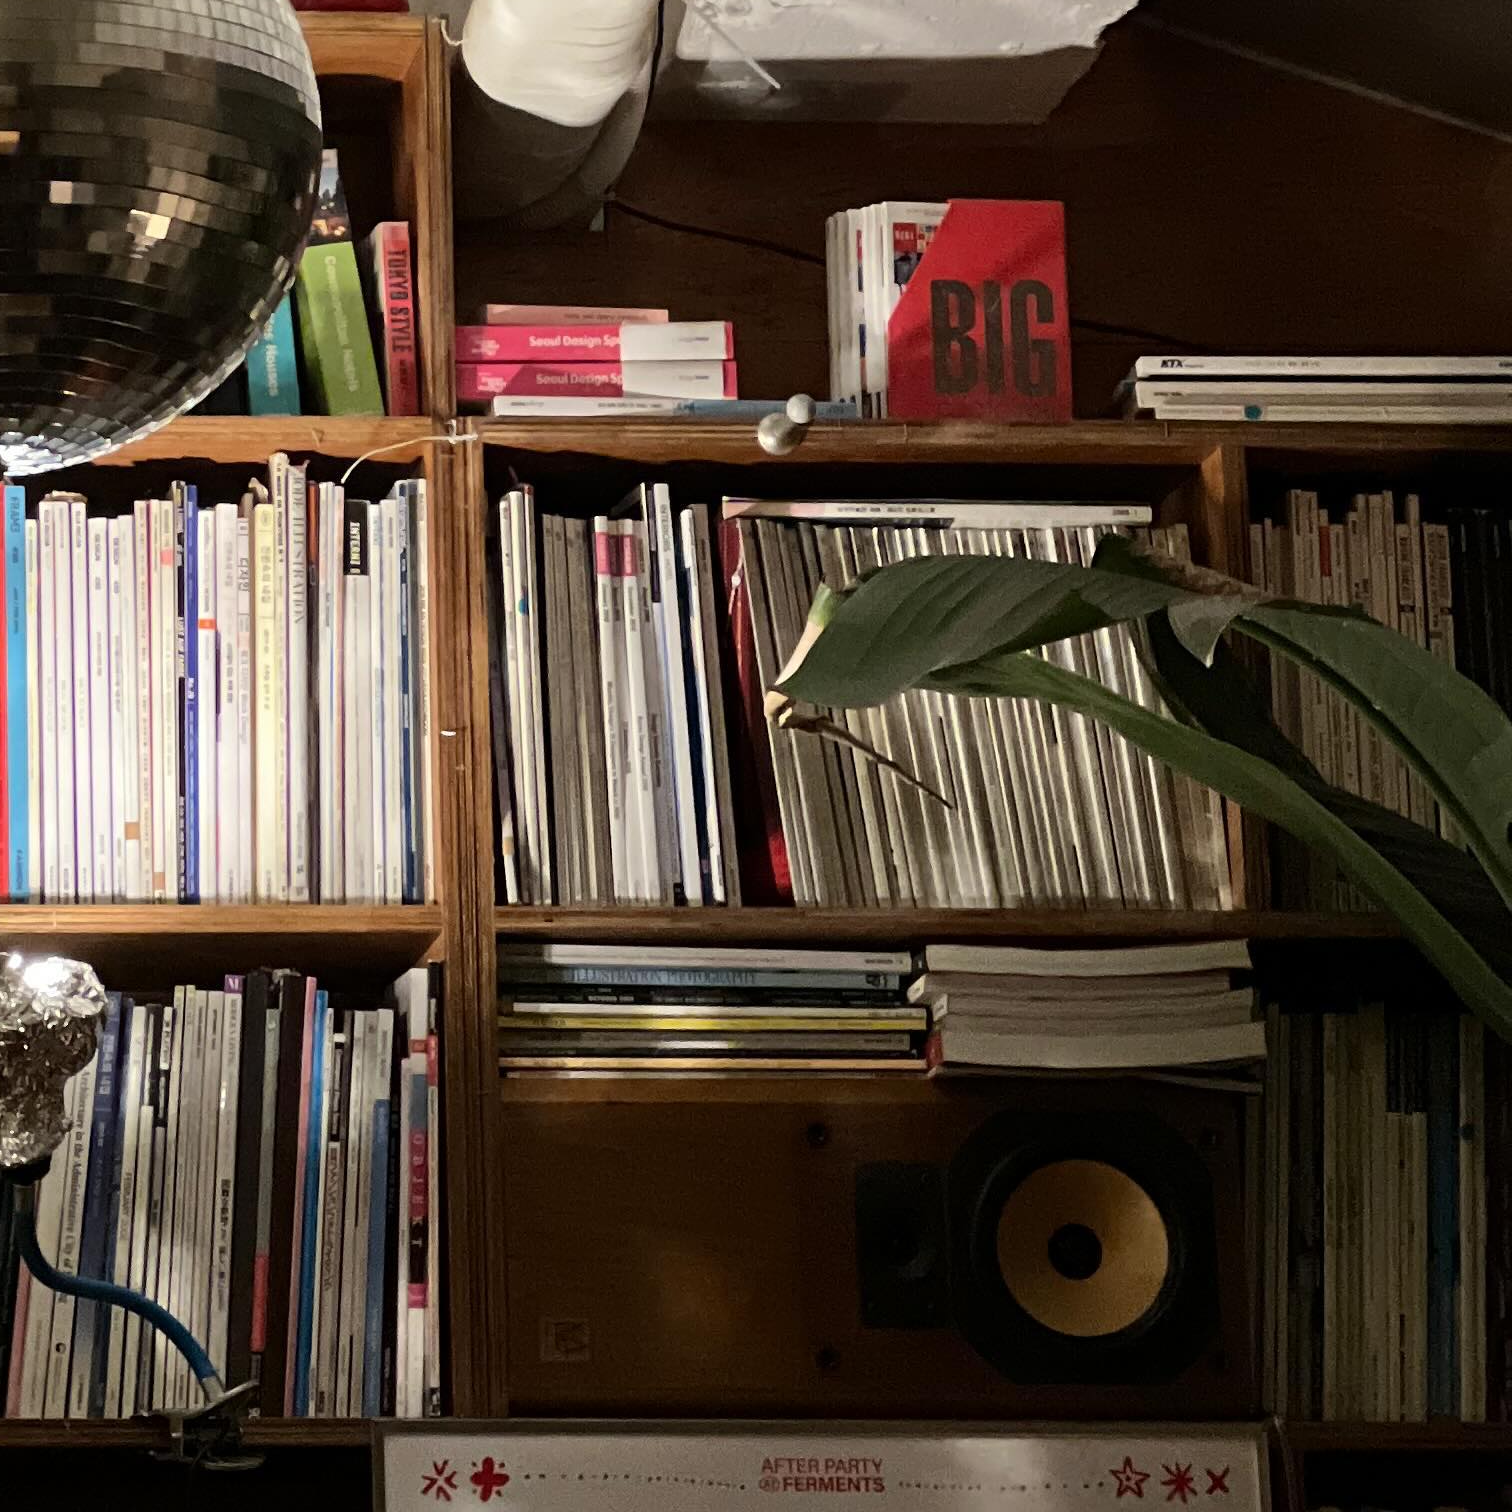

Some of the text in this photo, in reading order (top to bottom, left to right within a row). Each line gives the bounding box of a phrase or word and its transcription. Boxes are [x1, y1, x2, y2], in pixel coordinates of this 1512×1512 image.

[387, 248, 412, 352] TOKYO STYLE
[529, 336, 562, 348] Seoul
[563, 336, 602, 350] Design
[930, 279, 1057, 398] BIG
[536, 374, 569, 386] Seoul
[570, 374, 609, 388] Design
[349, 522, 359, 564] INTERNI
[236, 557, 249, 592] 디자인
[78, 1071, 90, 1127] Architecture
[73, 1144, 82, 1156] the
[65, 1162, 81, 1233] Administrative
[62, 1235, 74, 1255] City
[762, 1458, 883, 1474] AFTER PARTY
[783, 1476, 886, 1493] FERMENTS
